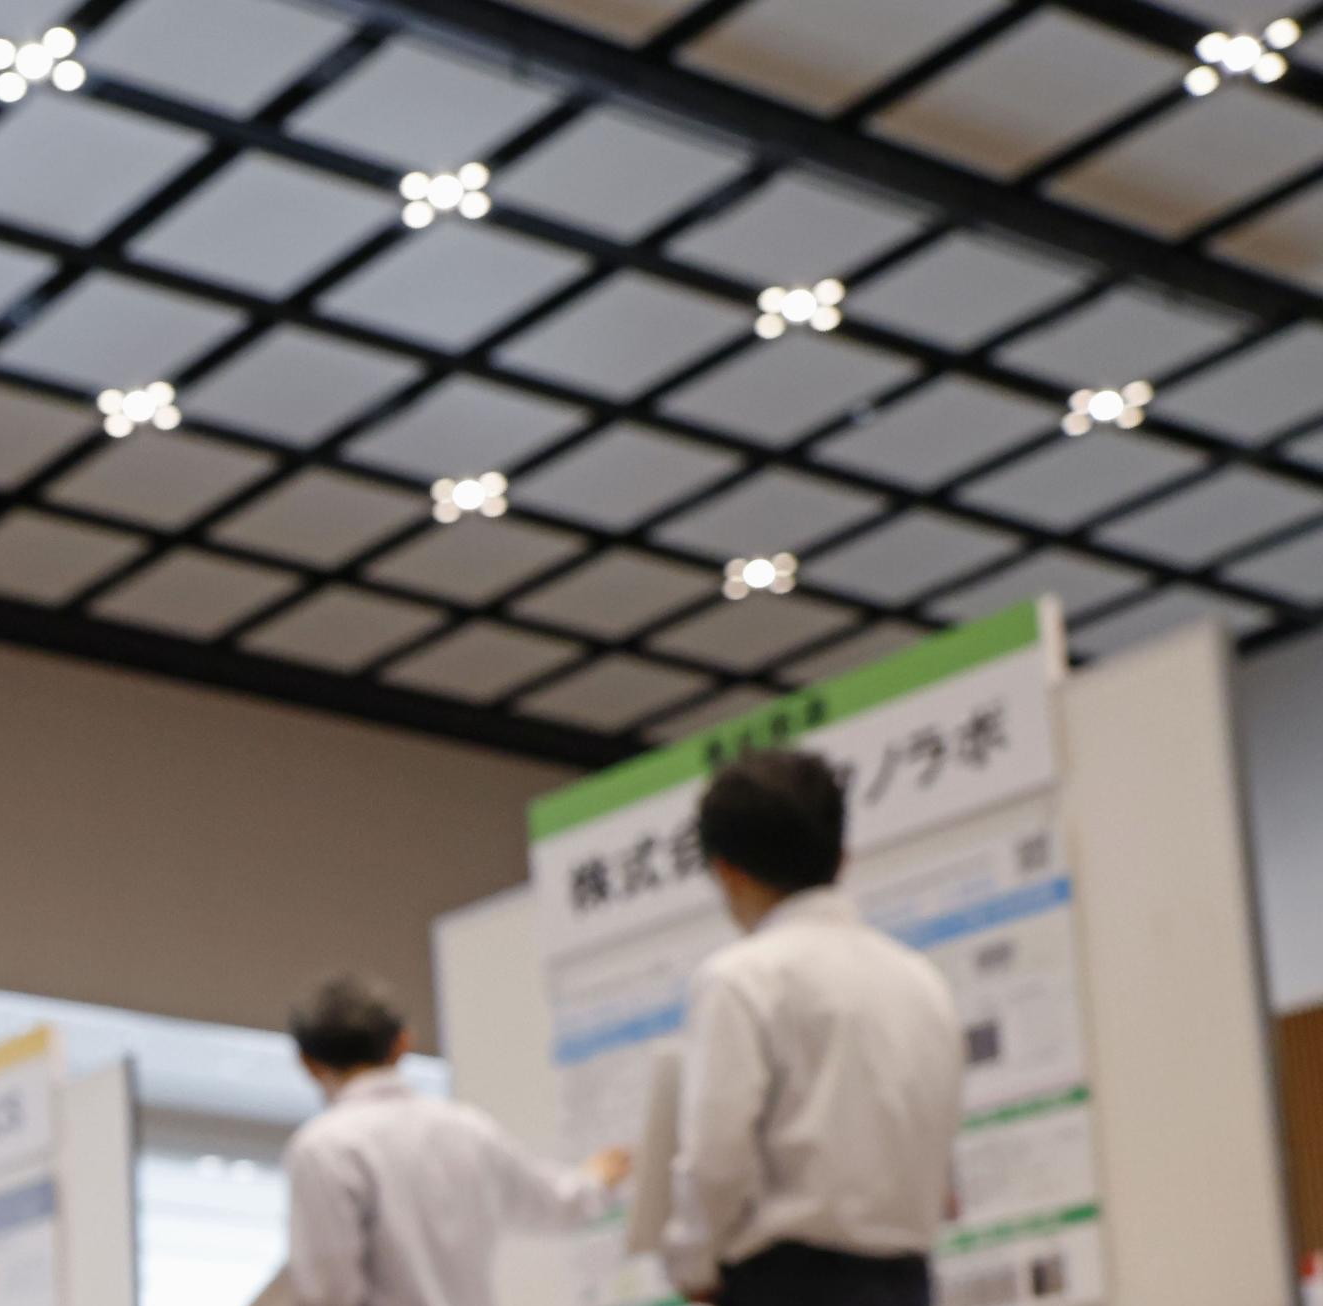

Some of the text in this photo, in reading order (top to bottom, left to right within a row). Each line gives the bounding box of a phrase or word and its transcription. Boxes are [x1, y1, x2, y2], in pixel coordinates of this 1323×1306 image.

[568, 702, 1010, 912] 株式会ノラボ
